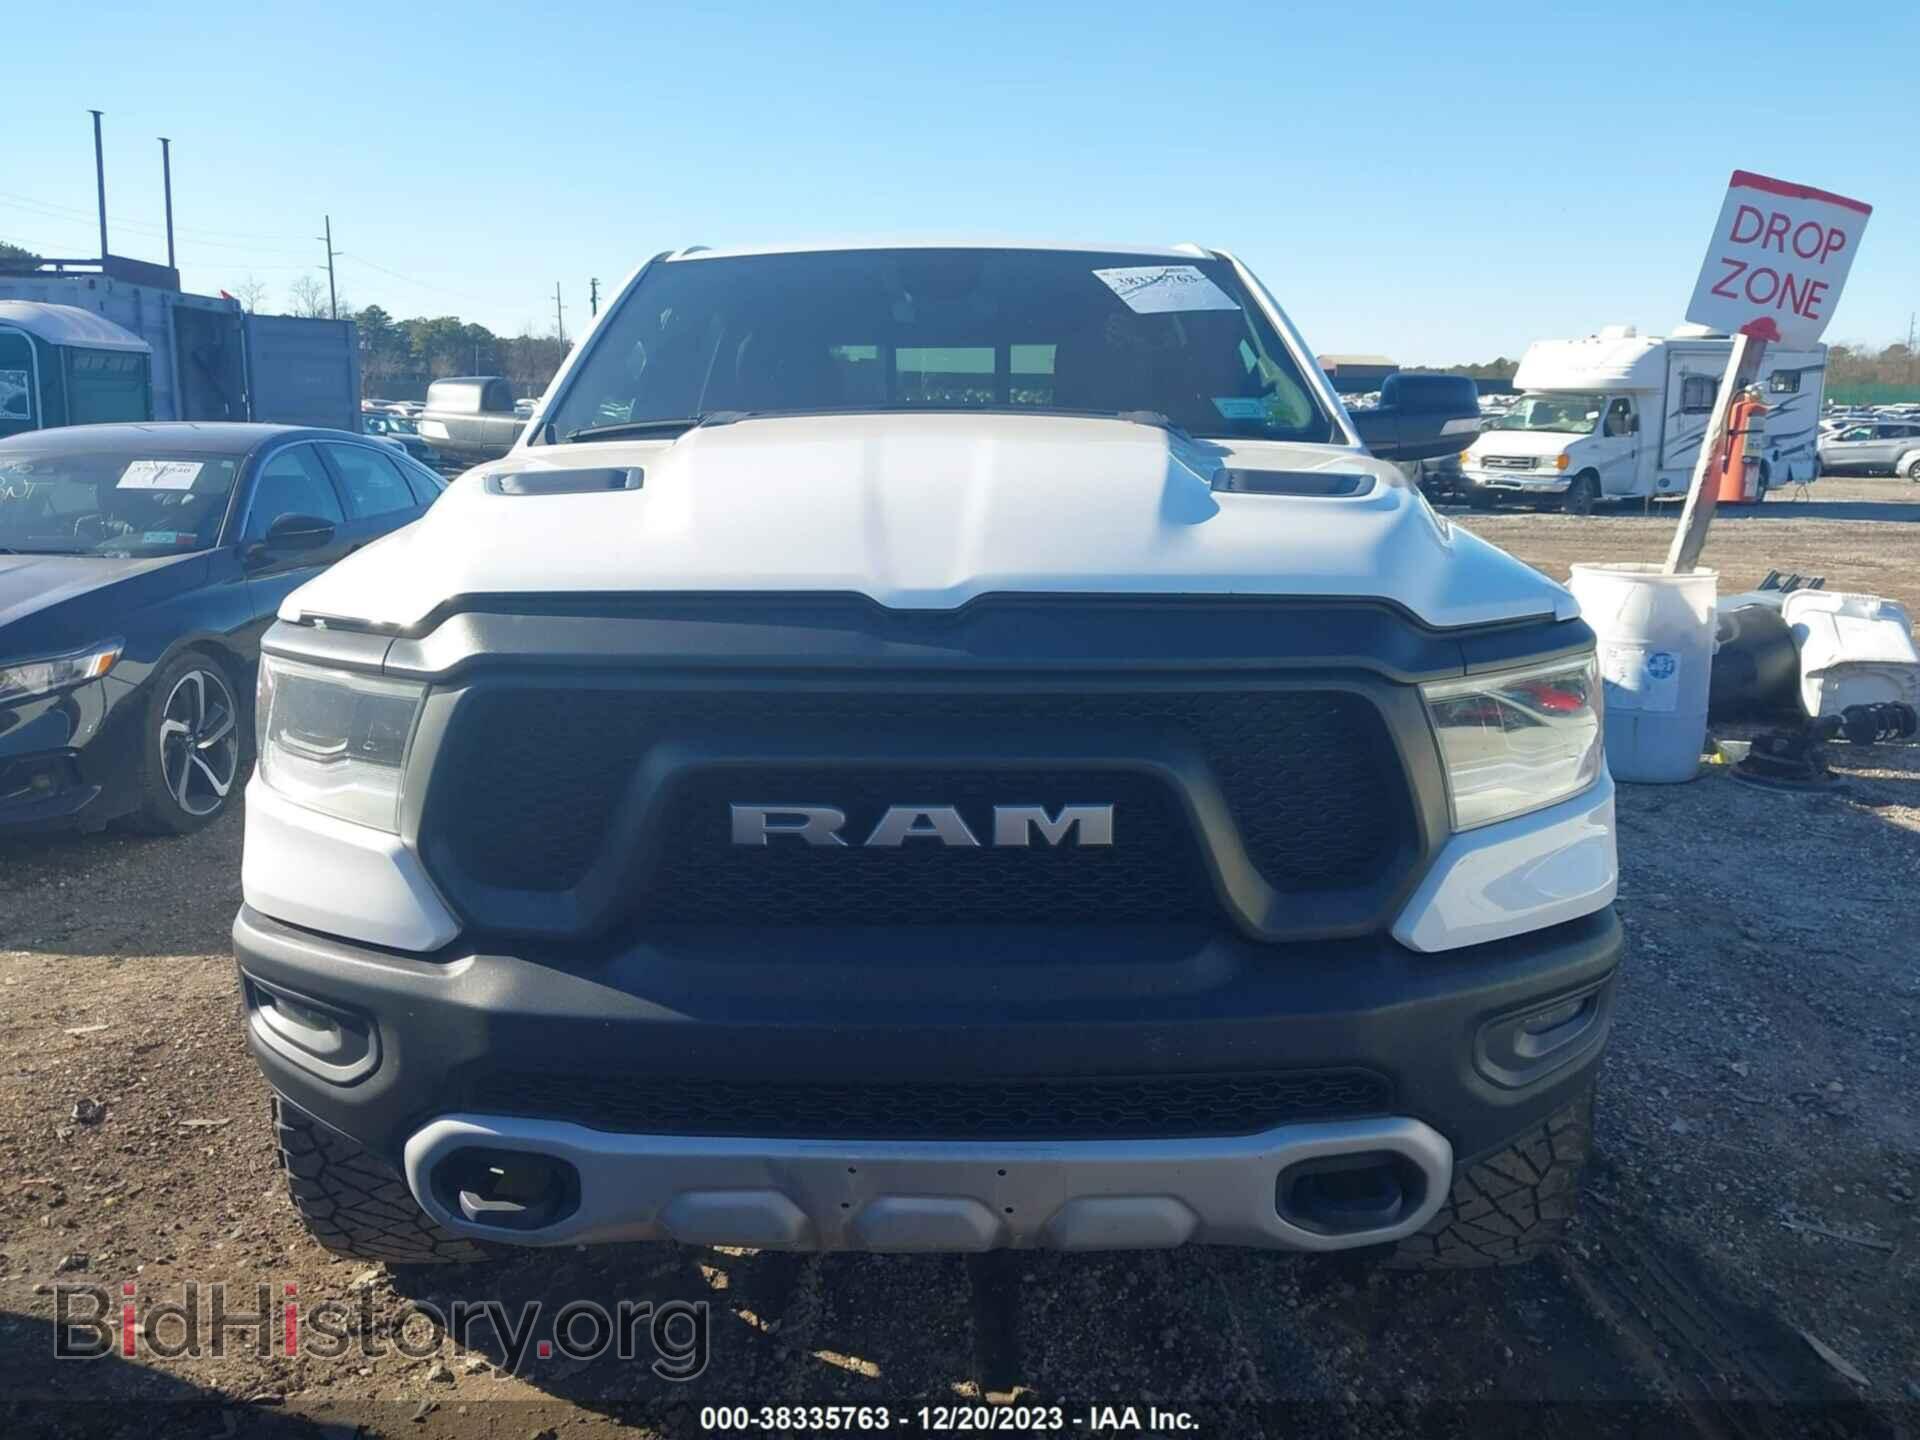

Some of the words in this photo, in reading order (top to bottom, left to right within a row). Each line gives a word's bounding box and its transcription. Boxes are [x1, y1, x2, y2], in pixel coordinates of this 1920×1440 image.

[1729, 205, 1846, 264] DROP
[1711, 257, 1829, 320] ZONE
[730, 803, 1114, 847] RAM
